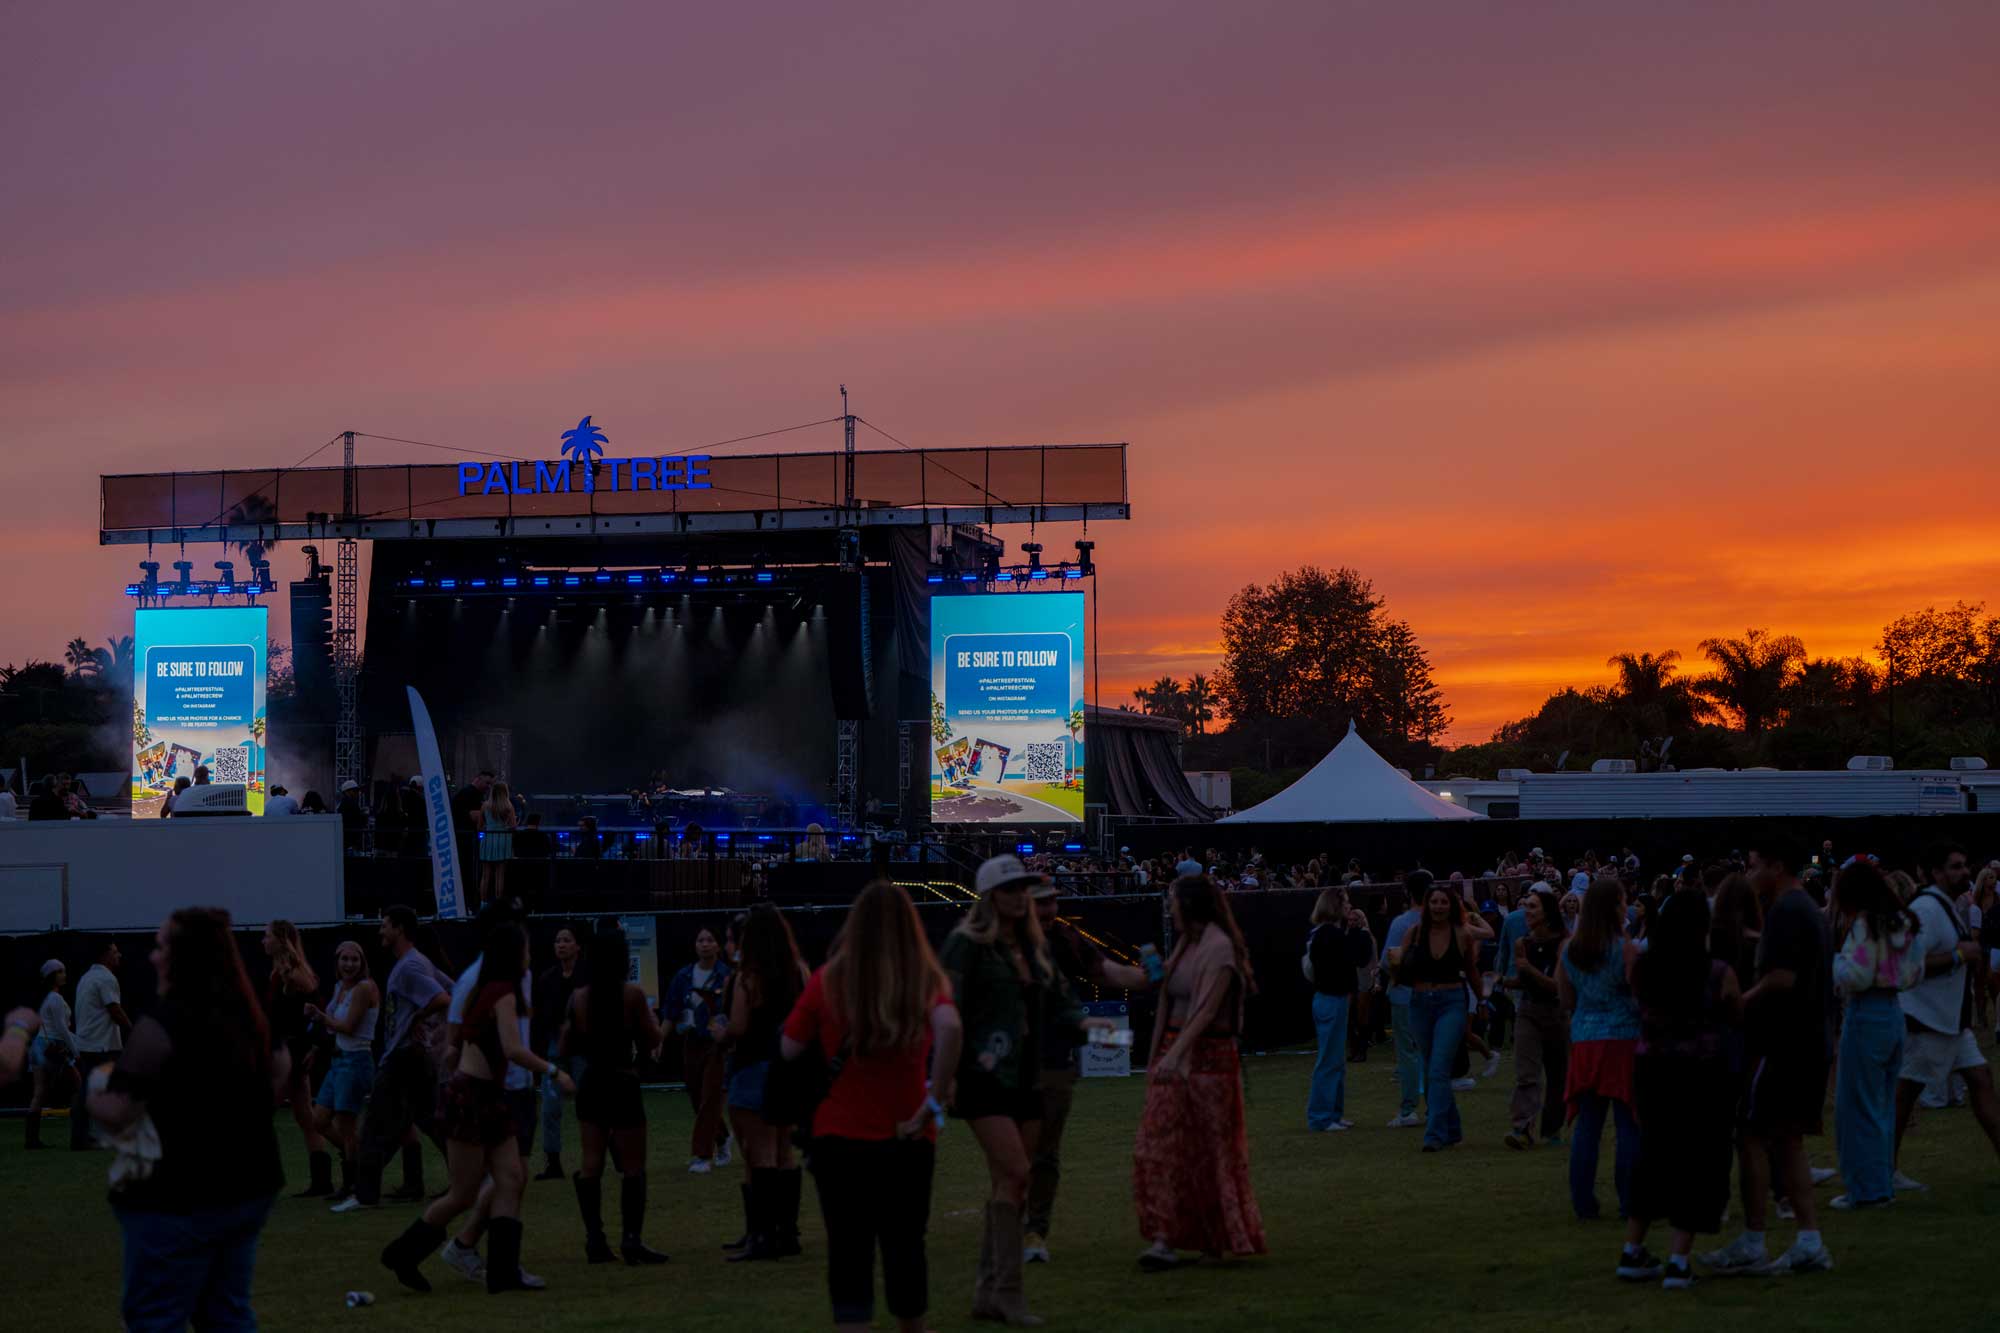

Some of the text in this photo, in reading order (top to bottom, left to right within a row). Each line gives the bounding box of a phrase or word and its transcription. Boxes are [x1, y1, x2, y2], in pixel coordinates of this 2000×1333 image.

[458, 455, 713, 496] PALM TREE
[958, 651, 1057, 668] BE SURE TO FOLLOW
[157, 661, 243, 677] BE SURE TO FOLLOW
